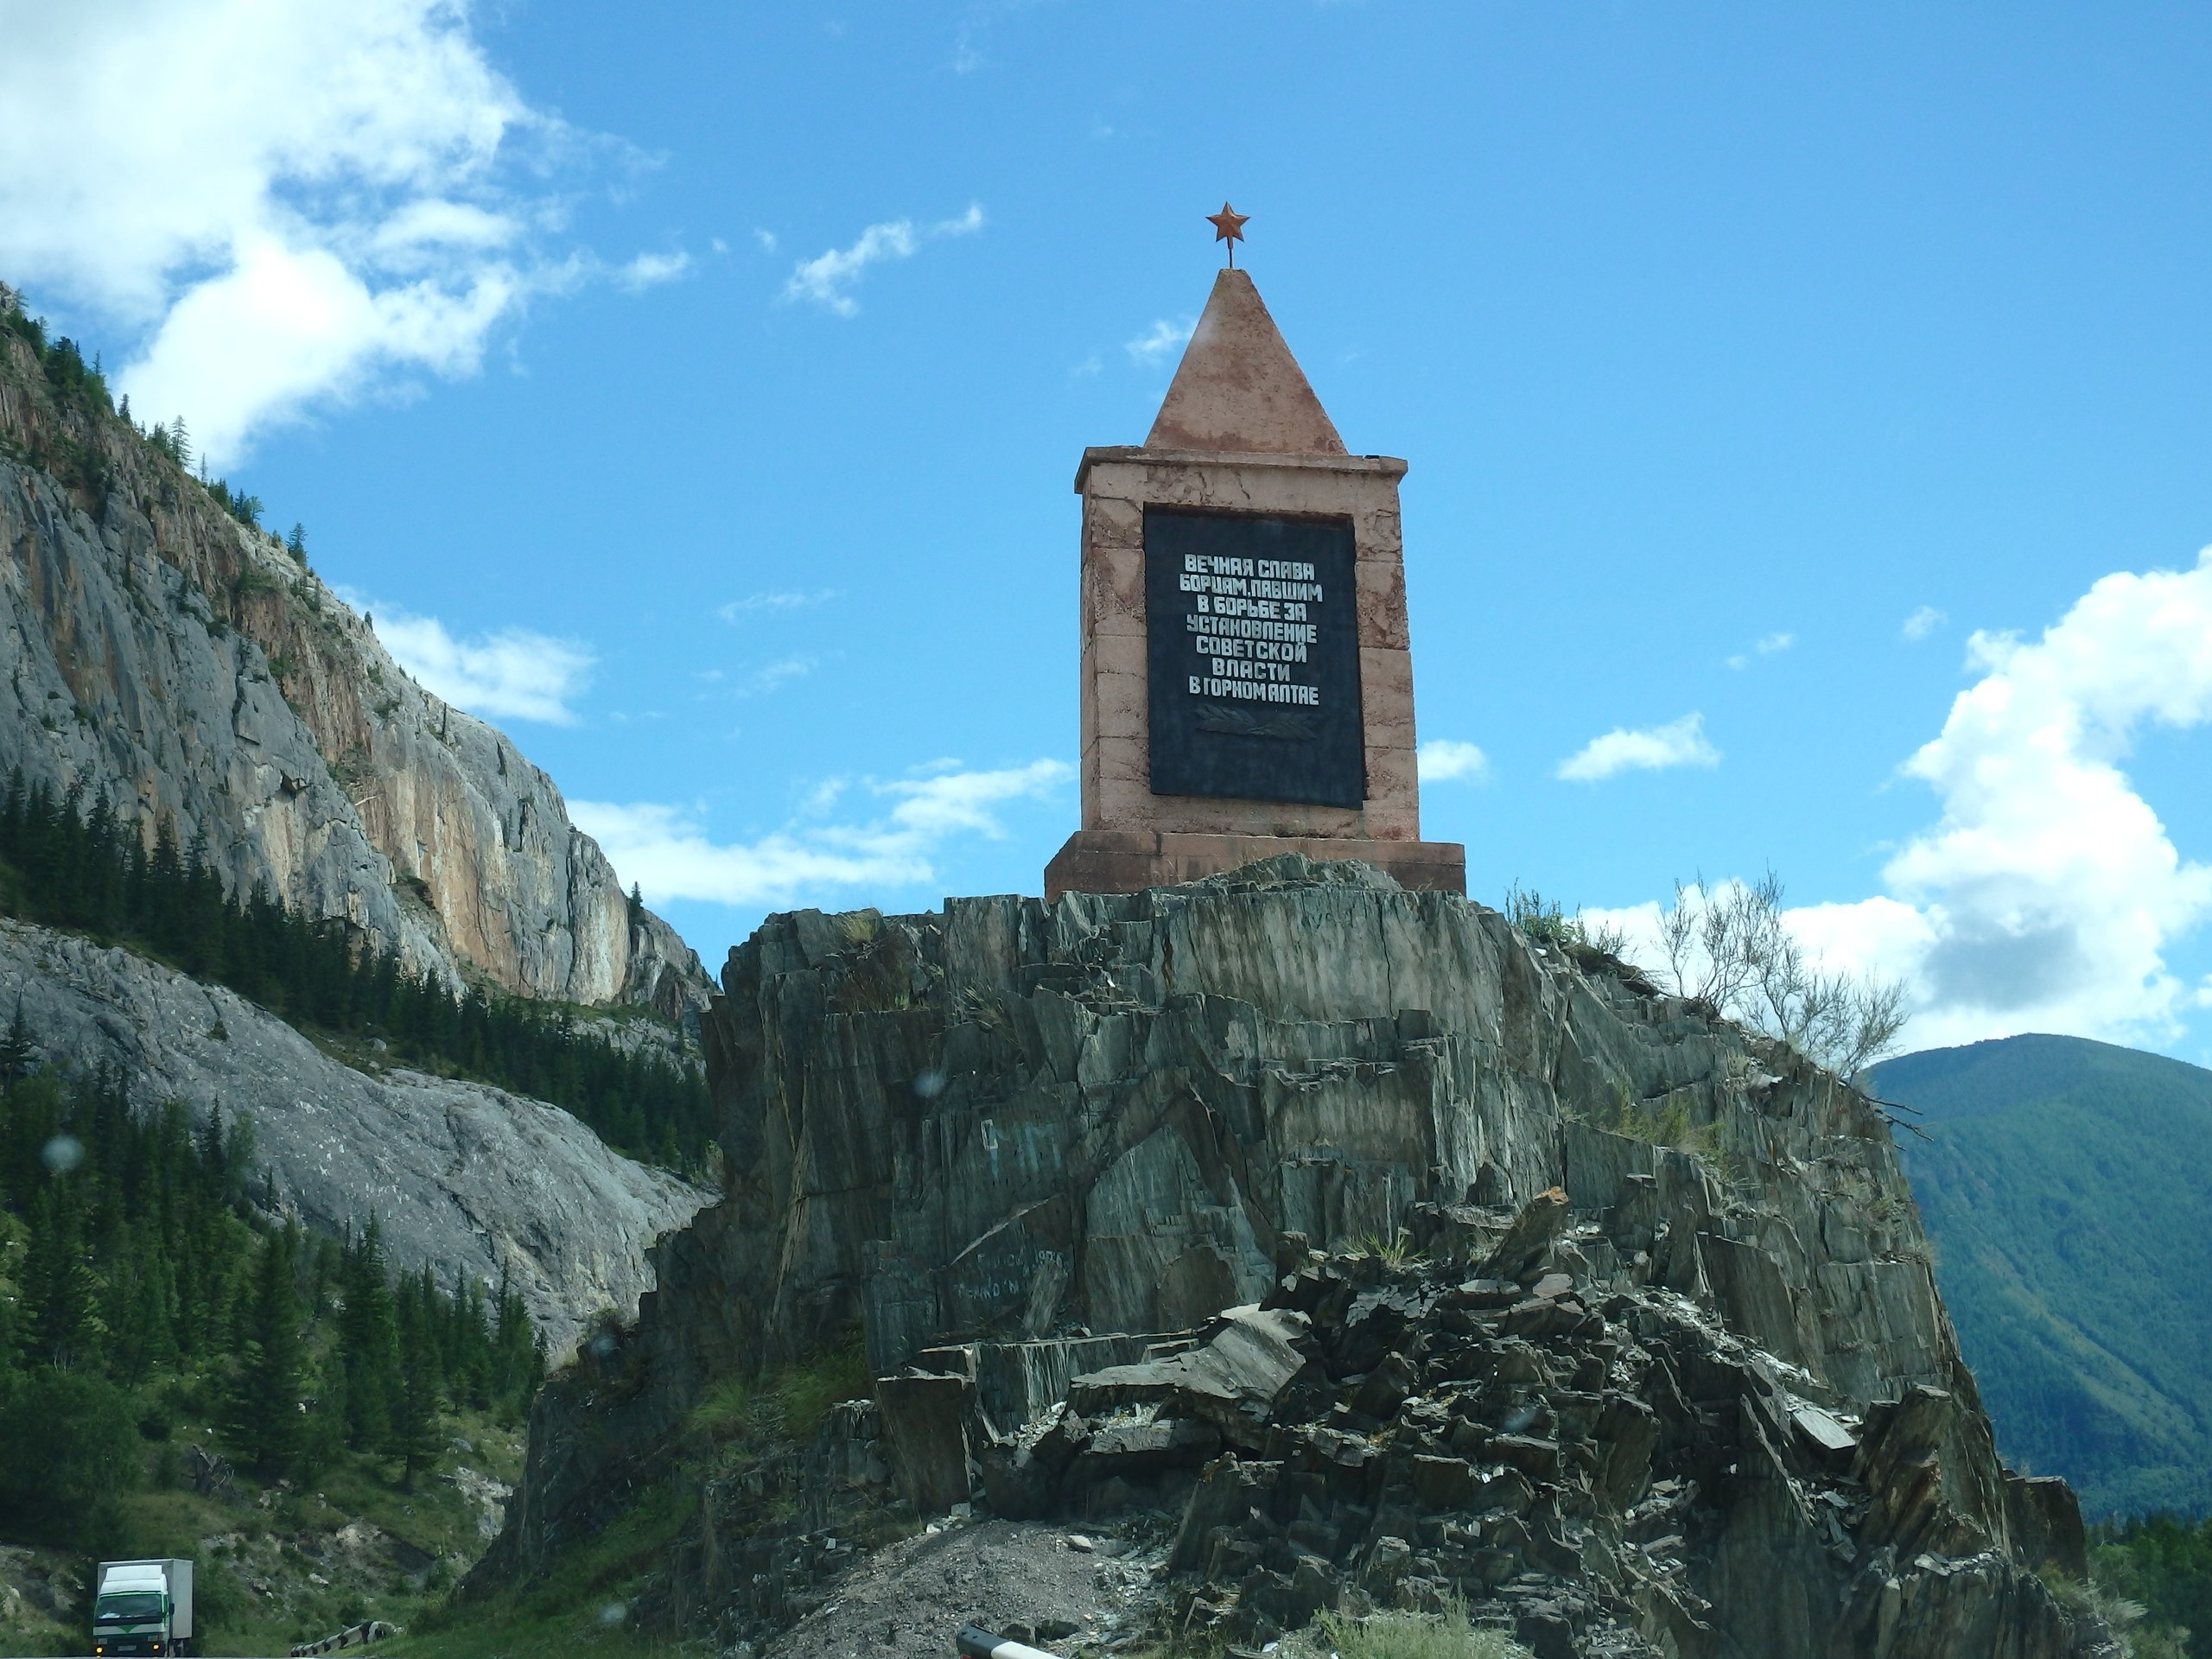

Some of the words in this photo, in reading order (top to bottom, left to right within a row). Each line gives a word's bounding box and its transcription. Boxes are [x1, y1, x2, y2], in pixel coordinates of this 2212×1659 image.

[1185, 554, 1254, 576] ВЕЧНАЯ
[1258, 560, 1314, 581] СЛАВА
[1198, 595, 1209, 613] В
[1214, 596, 1281, 619] БОРЬБЕ
[1284, 602, 1306, 621] ЗА
[1186, 614, 1318, 643] УСТАНОВЛЕНИЕ
[1196, 635, 1307, 663] СОВЕТСКОЙ
[1212, 658, 1290, 682] ВЛАСТИ
[1189, 677, 1201, 694] В
[1204, 678, 1266, 701] ГОРНОМ
[1268, 684, 1319, 705] АЛТАЕ
